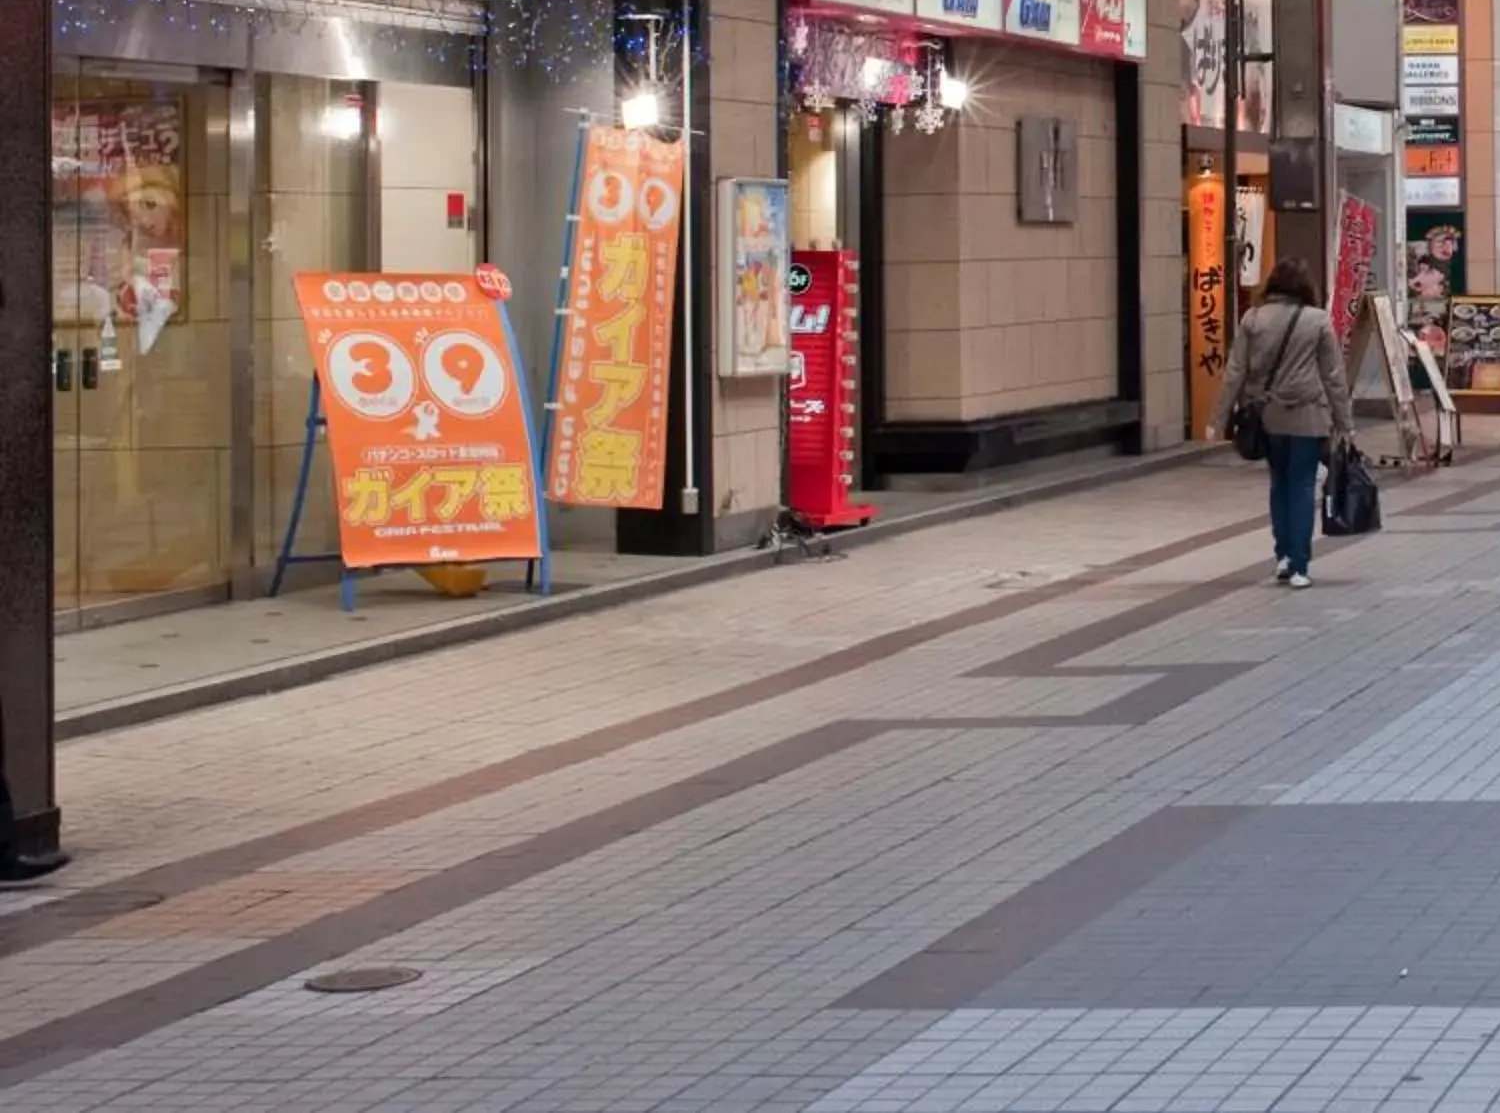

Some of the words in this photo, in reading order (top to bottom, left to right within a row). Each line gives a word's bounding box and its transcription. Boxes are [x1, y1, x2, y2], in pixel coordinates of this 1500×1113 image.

[1193, 265, 1224, 377] ばりきや
[347, 341, 393, 394] 3
[441, 342, 485, 395] 9
[576, 232, 650, 501] ガイア祭
[346, 466, 531, 524] ガイア祭
